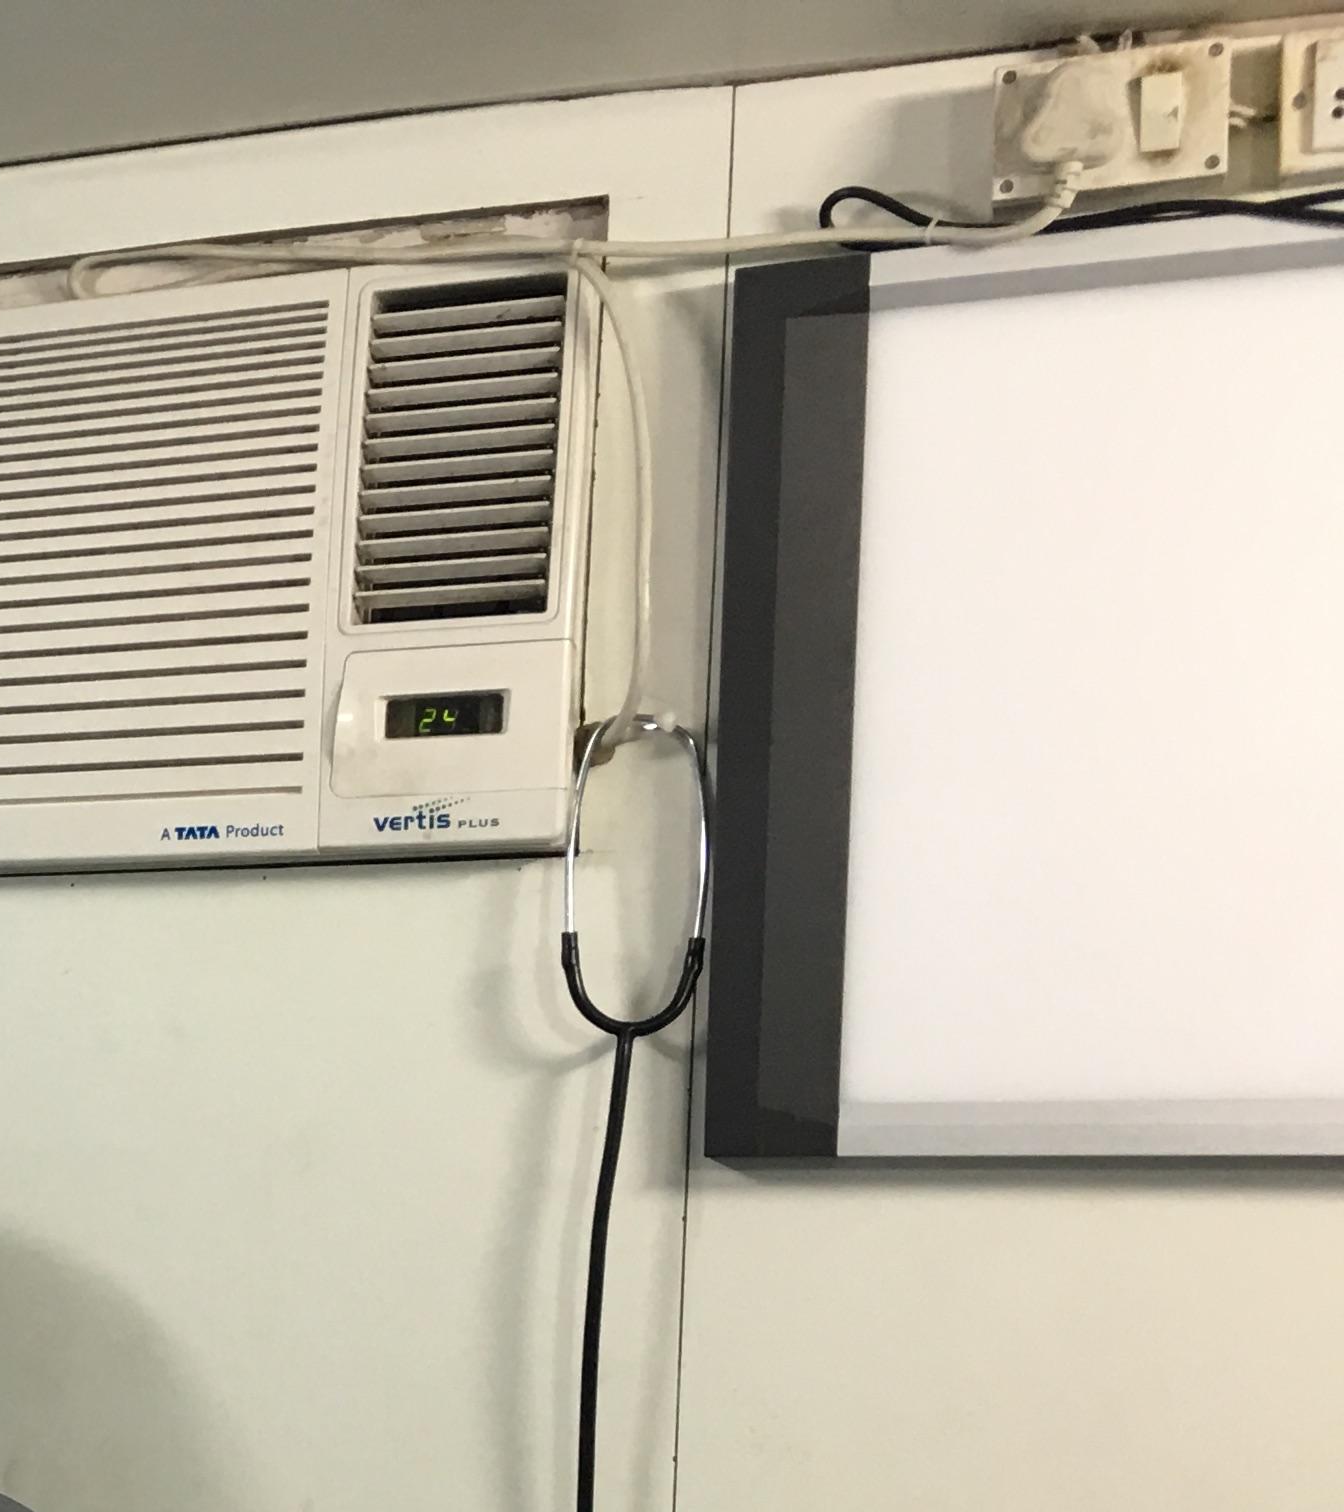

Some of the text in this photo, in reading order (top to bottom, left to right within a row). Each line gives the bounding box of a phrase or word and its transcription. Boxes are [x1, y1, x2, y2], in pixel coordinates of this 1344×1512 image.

[418, 708, 460, 734] 24
[160, 823, 285, 841] A TATA Product
[457, 817, 500, 829] PLUS
